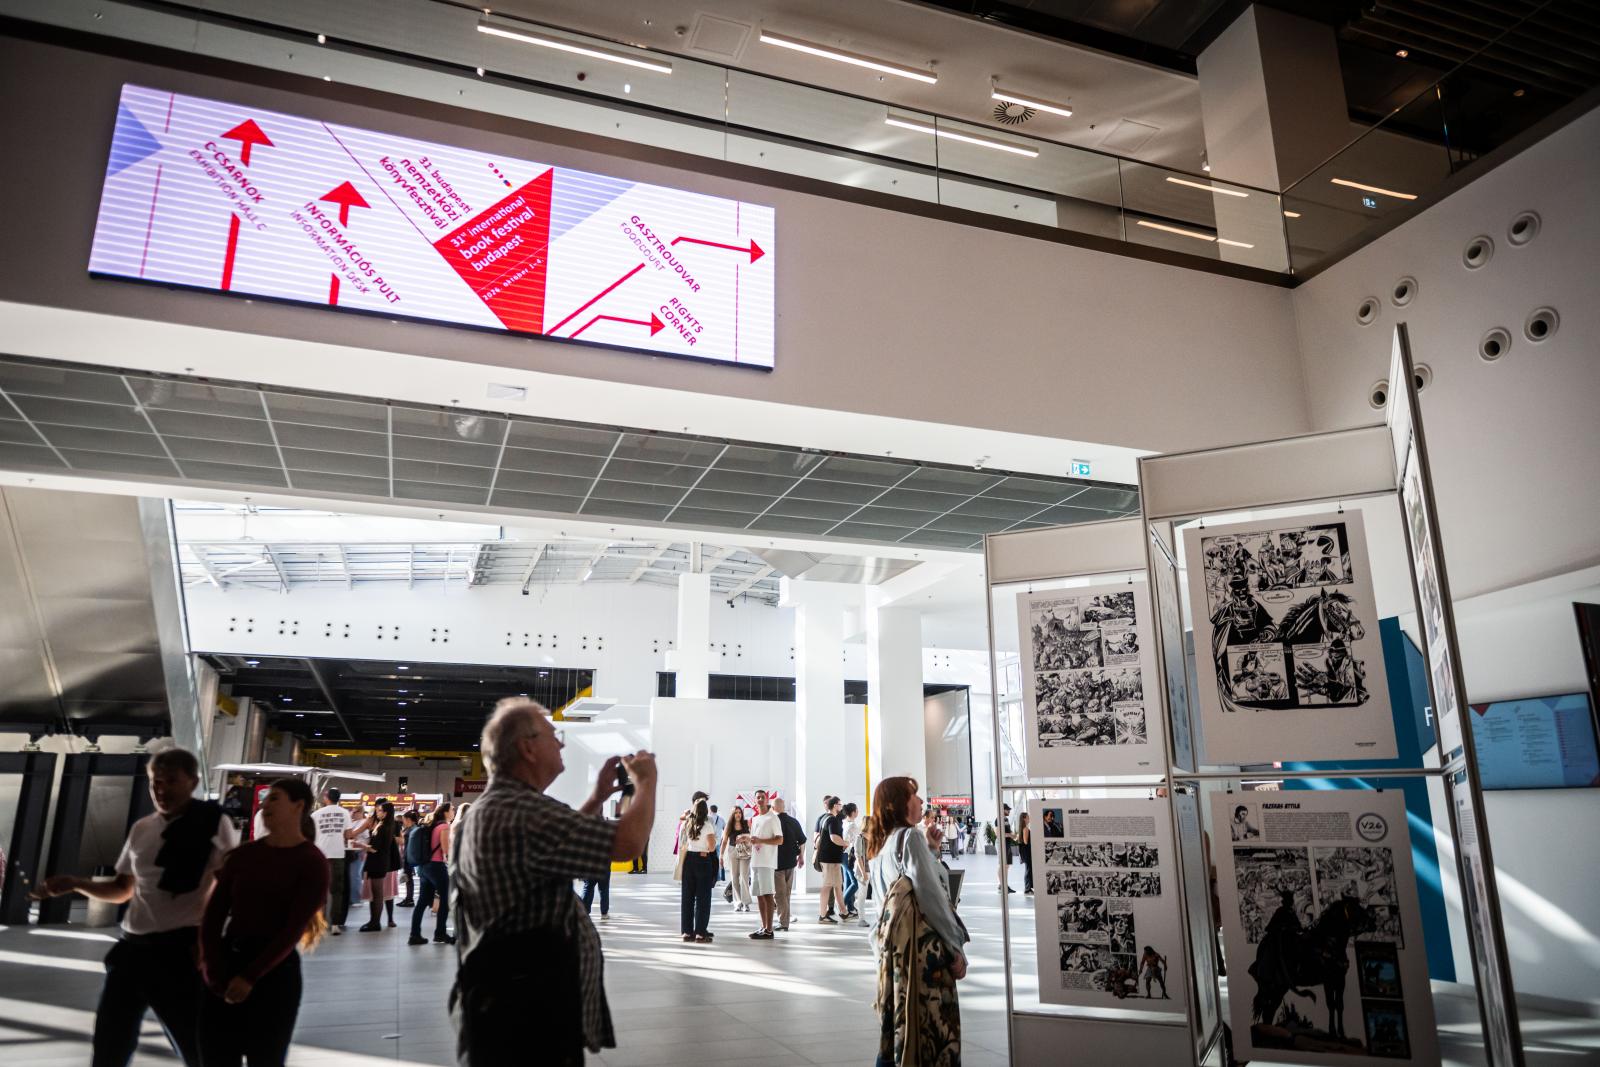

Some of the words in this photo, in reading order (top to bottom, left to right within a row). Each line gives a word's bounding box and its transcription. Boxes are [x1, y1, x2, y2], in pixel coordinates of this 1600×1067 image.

[189, 149, 238, 201] EXHIBITION
[235, 200, 259, 226] HALL
[204, 141, 265, 202] C-CSARNOK
[379, 157, 449, 229] könyvfesztivál
[400, 159, 462, 222] nemzetközi
[419, 156, 431, 170] 31.
[432, 170, 473, 214] budapesti
[458, 234, 494, 260] book
[491, 206, 535, 240] festival
[468, 195, 526, 237] international
[289, 209, 348, 272] INFORMATION
[347, 272, 371, 294] DESK
[304, 202, 375, 277] INFORMÁCIÓS
[373, 276, 402, 305] PULT
[470, 234, 525, 272] budapest
[620, 223, 665, 271] FOODCOURT
[631, 216, 700, 292] GASZTROUDVAR
[660, 306, 696, 346] CORNER
[669, 298, 703, 333] RIGHTS
